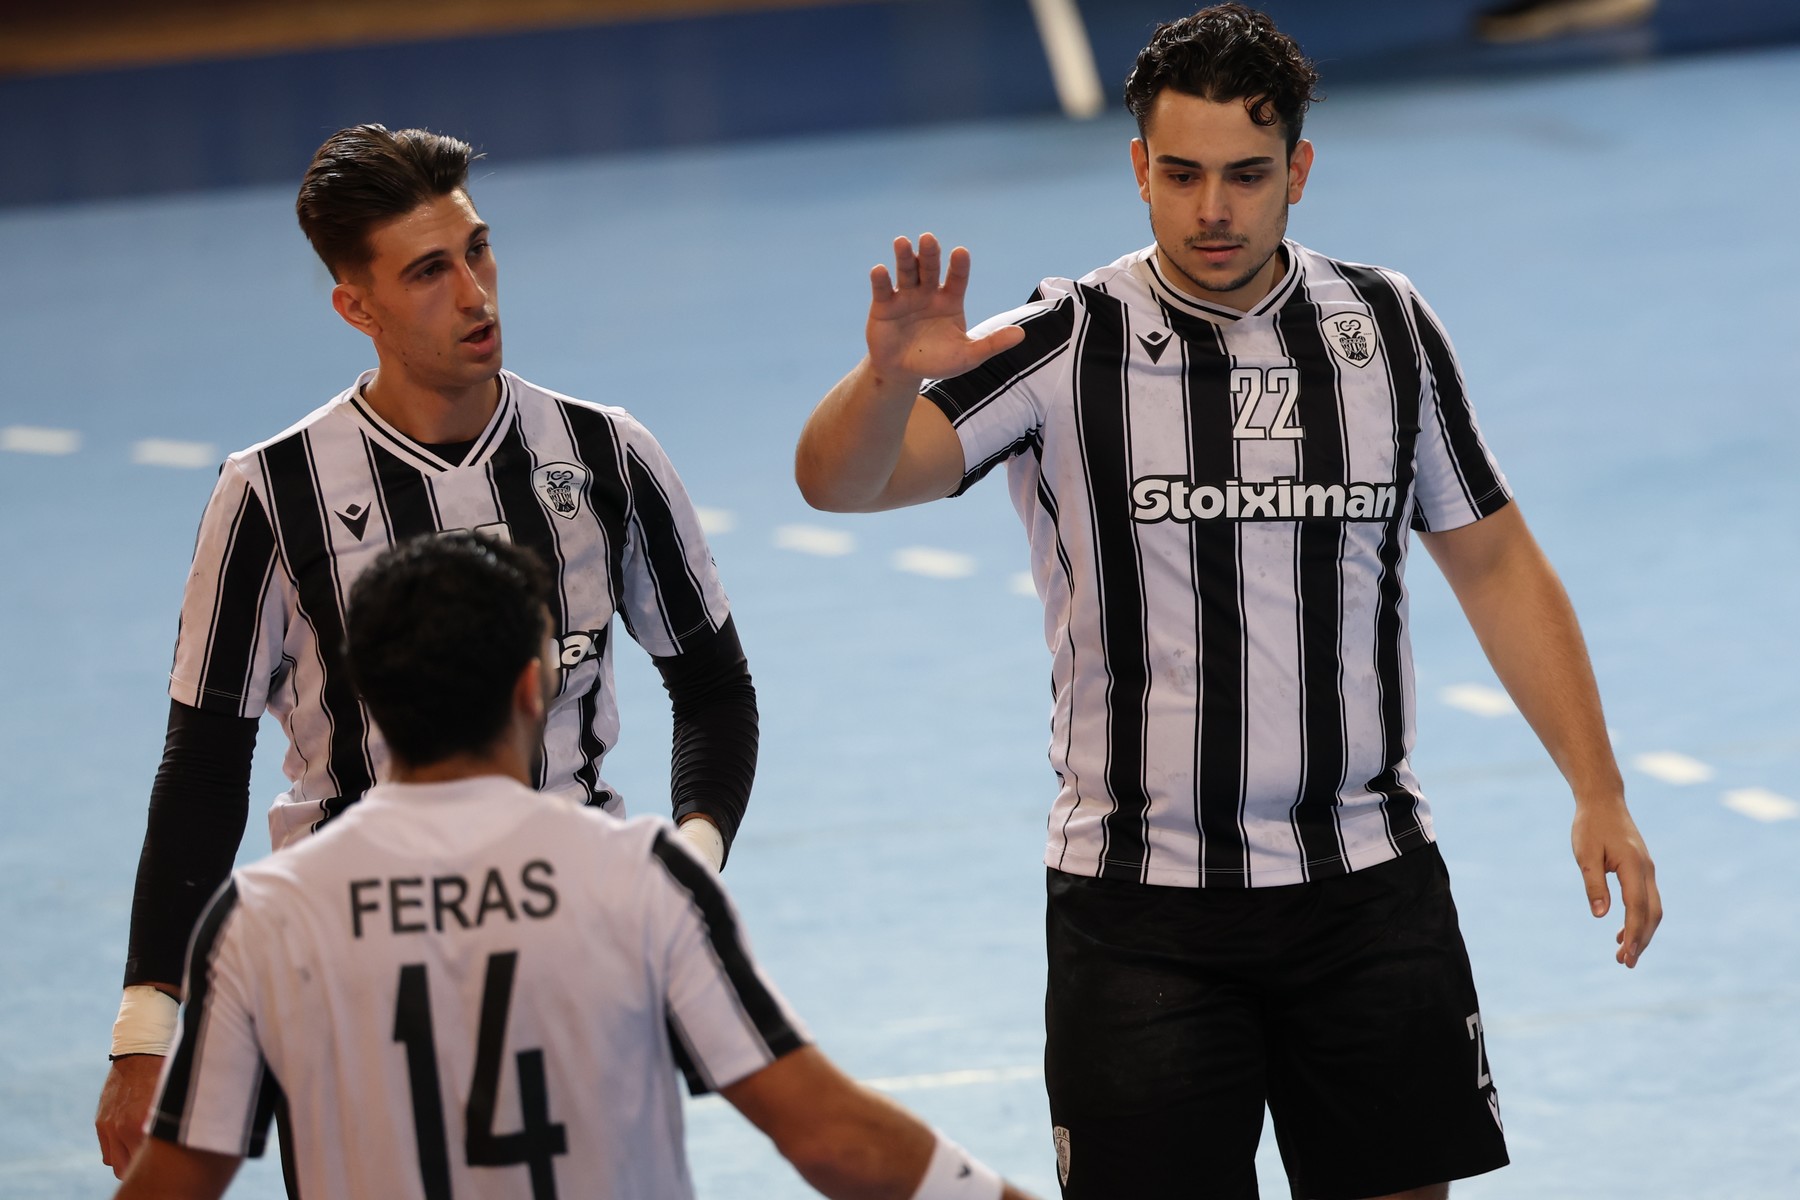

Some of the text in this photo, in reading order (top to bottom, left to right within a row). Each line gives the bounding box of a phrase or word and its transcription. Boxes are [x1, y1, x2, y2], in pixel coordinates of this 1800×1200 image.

[1230, 367, 1306, 440] 22
[1131, 477, 1398, 520] Stoiximan
[349, 859, 560, 940] FERAS
[393, 950, 569, 1200] 14
[1465, 1011, 1490, 1089] 2
